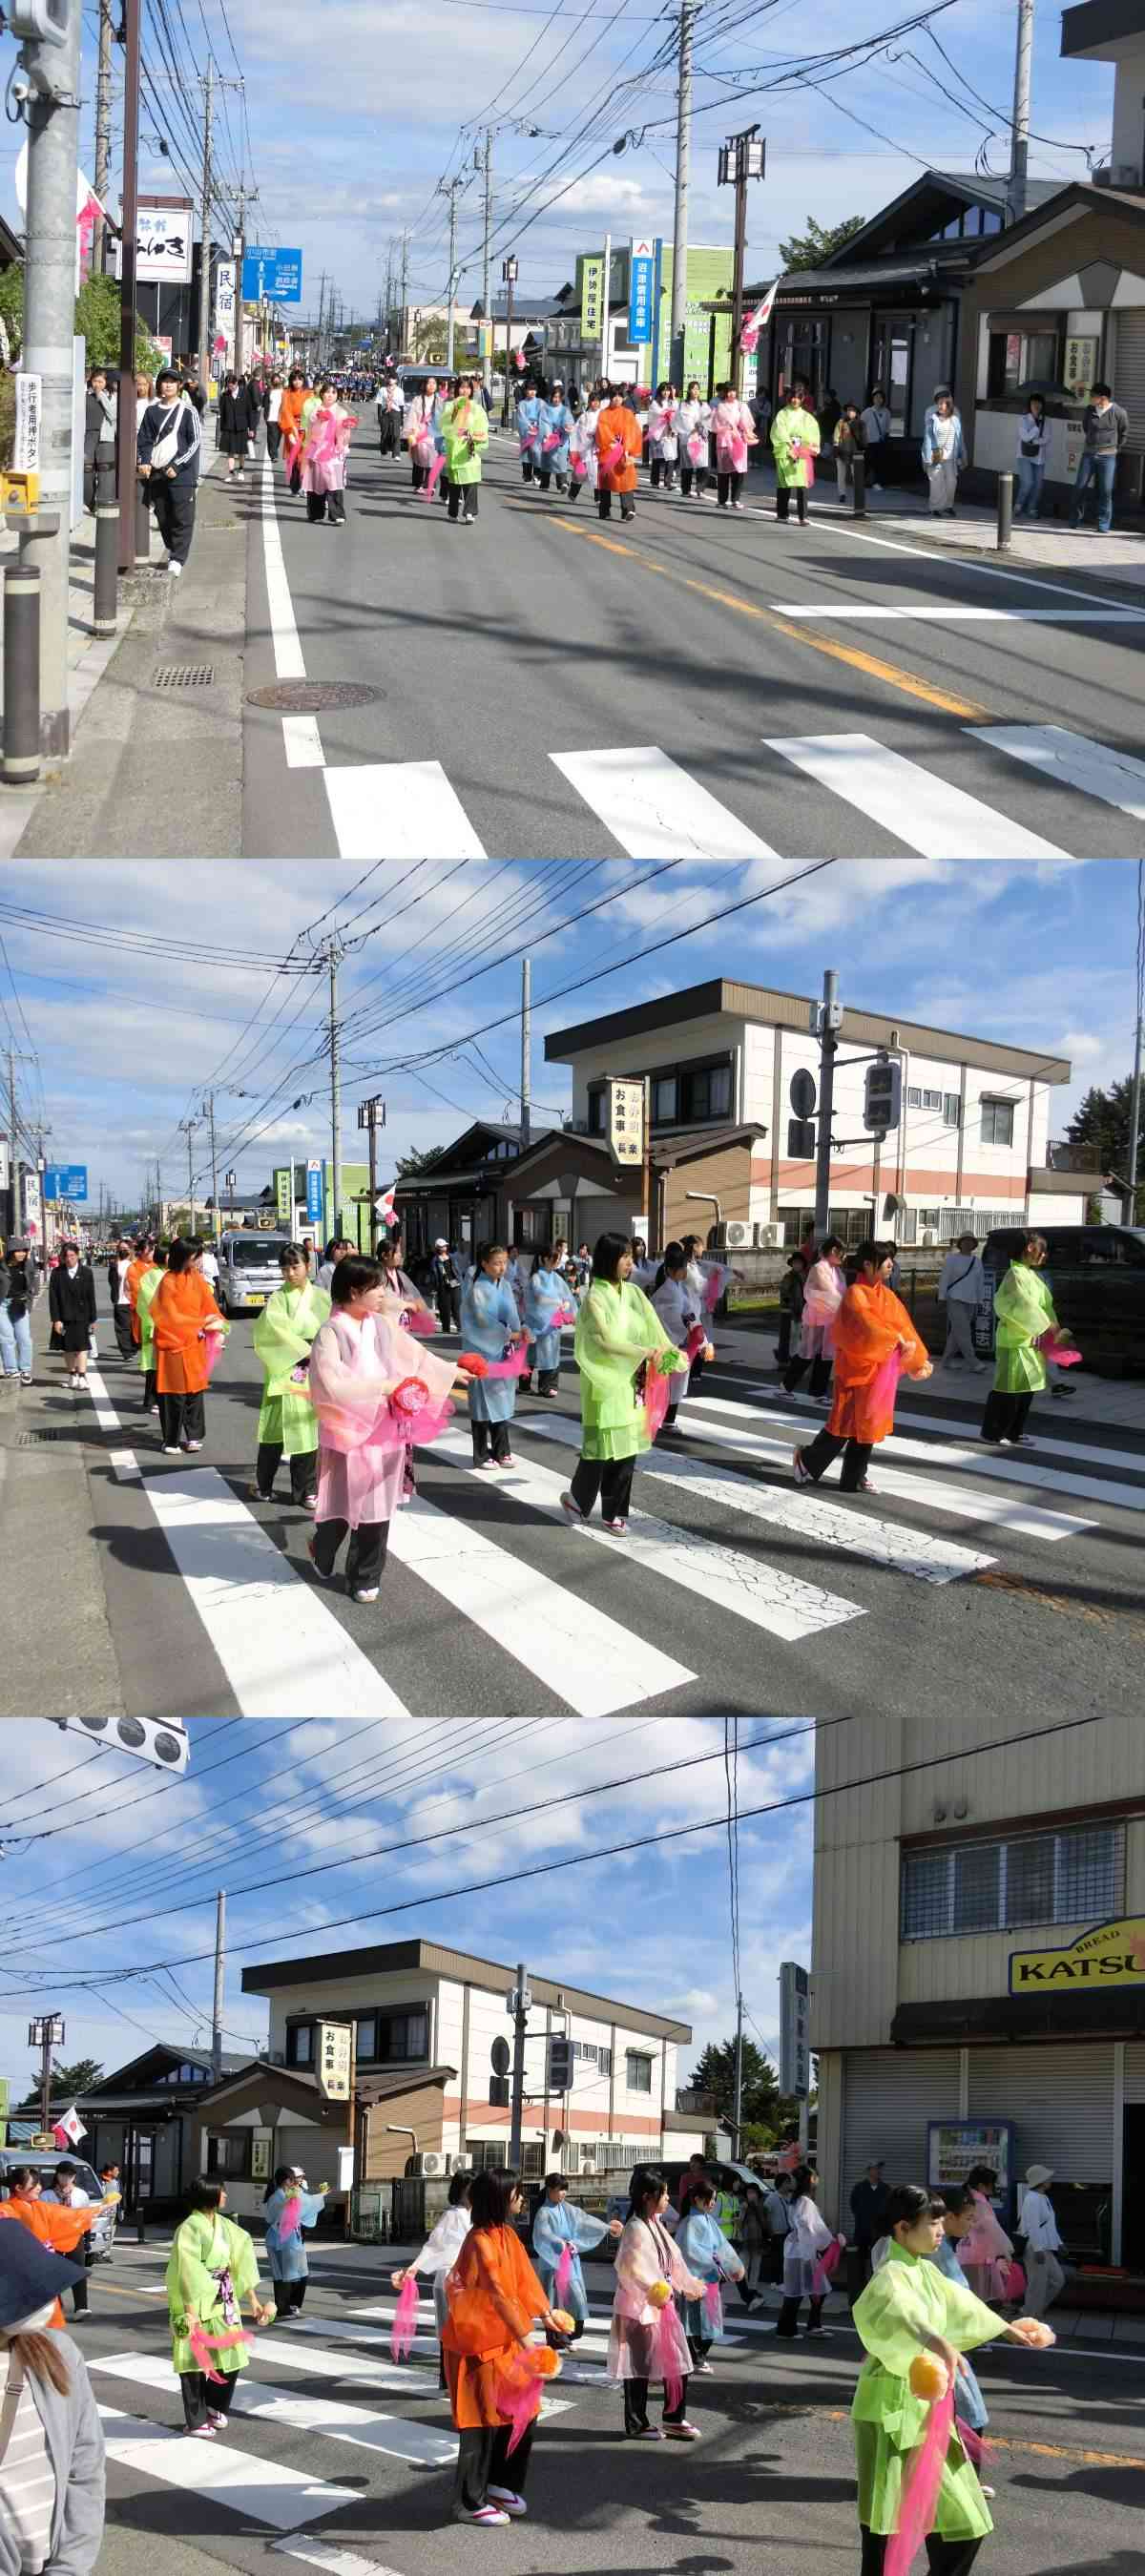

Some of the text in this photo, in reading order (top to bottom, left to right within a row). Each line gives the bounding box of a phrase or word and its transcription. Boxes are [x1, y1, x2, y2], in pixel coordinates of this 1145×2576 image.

[220, 270, 234, 310] 民宿
[635, 262, 648, 328] 沼津信用金庫
[614, 1090, 626, 1132] お食事
[1075, 1930, 1121, 1954] BREAD
[1019, 1954, 1145, 1982] KATSU
[325, 2030, 335, 2069] お食事
